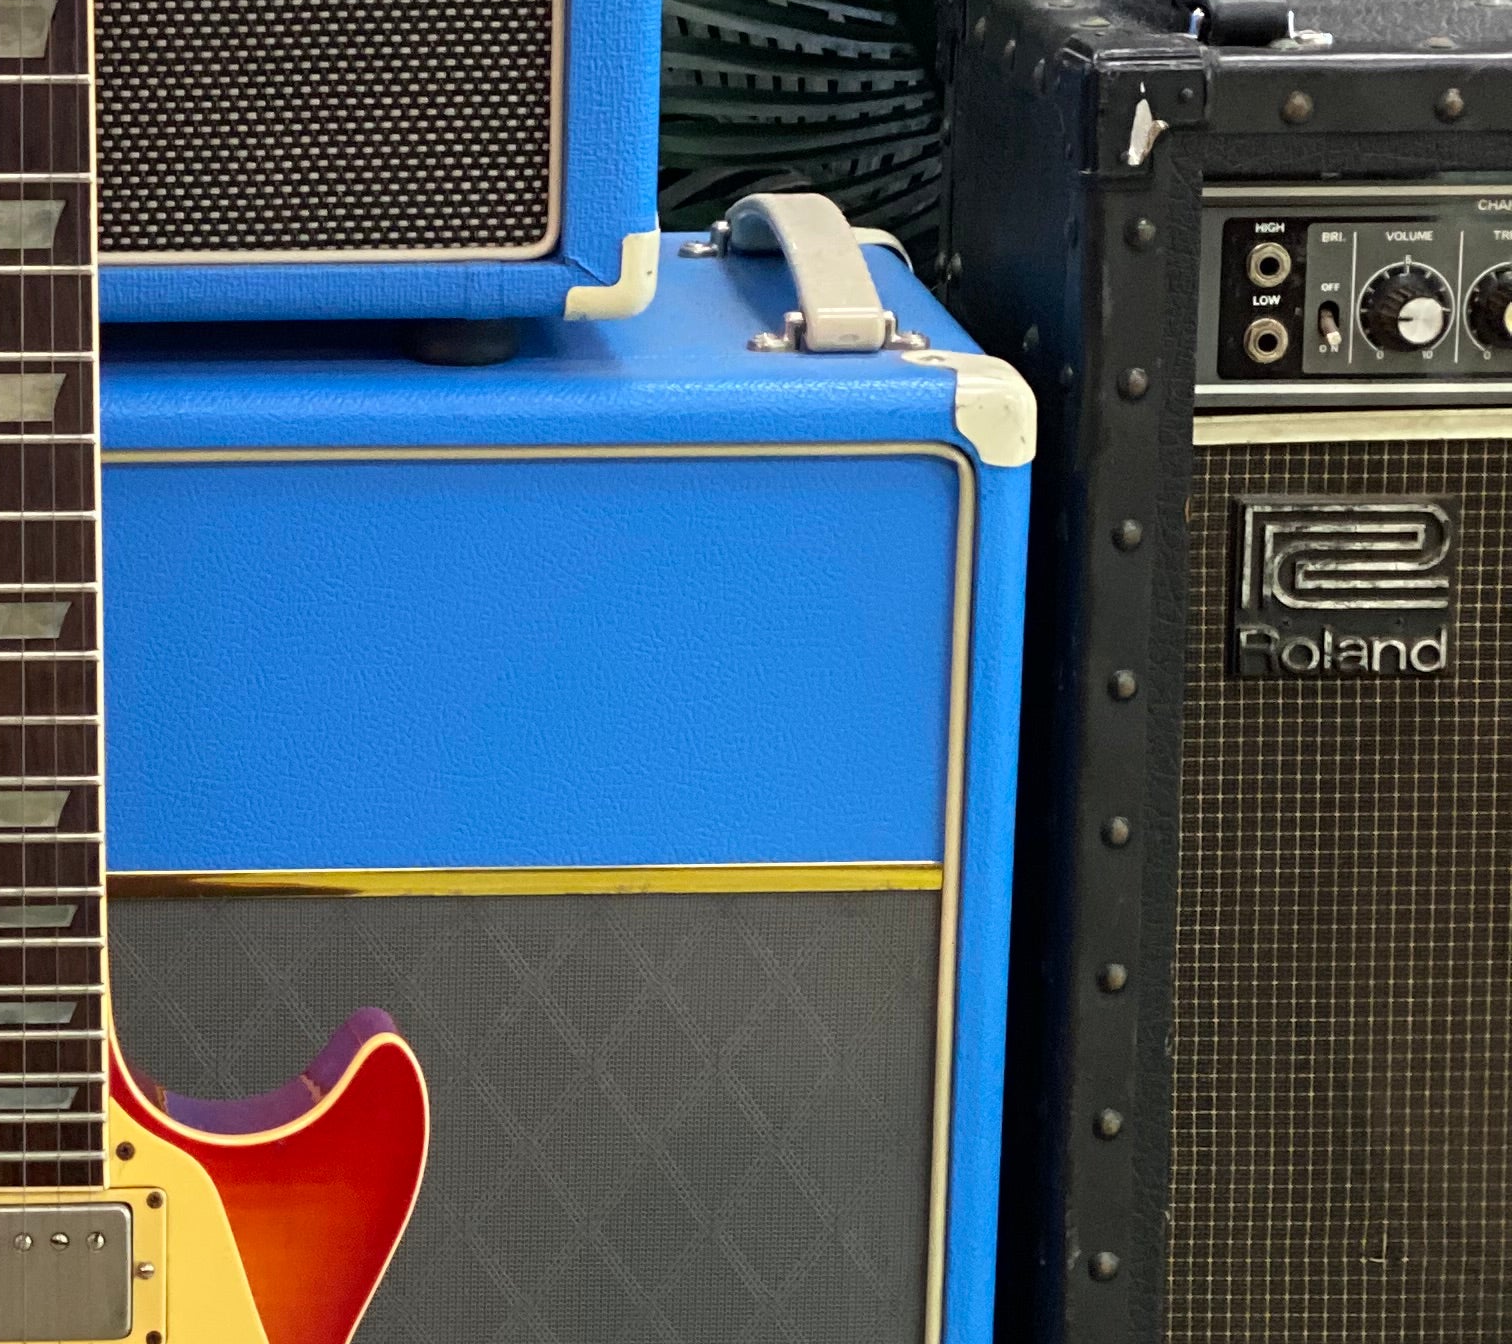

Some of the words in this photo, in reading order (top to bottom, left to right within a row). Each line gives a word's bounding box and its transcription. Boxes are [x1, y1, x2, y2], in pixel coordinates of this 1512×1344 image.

[1255, 222, 1285, 234] HIGH
[1321, 231, 1347, 243] BRI.
[1385, 230, 1434, 242] VOLUME
[1320, 282, 1340, 293] OFF
[1252, 294, 1281, 307] LOW
[1421, 350, 1434, 360] 10
[1239, 623, 1449, 674] Roland
